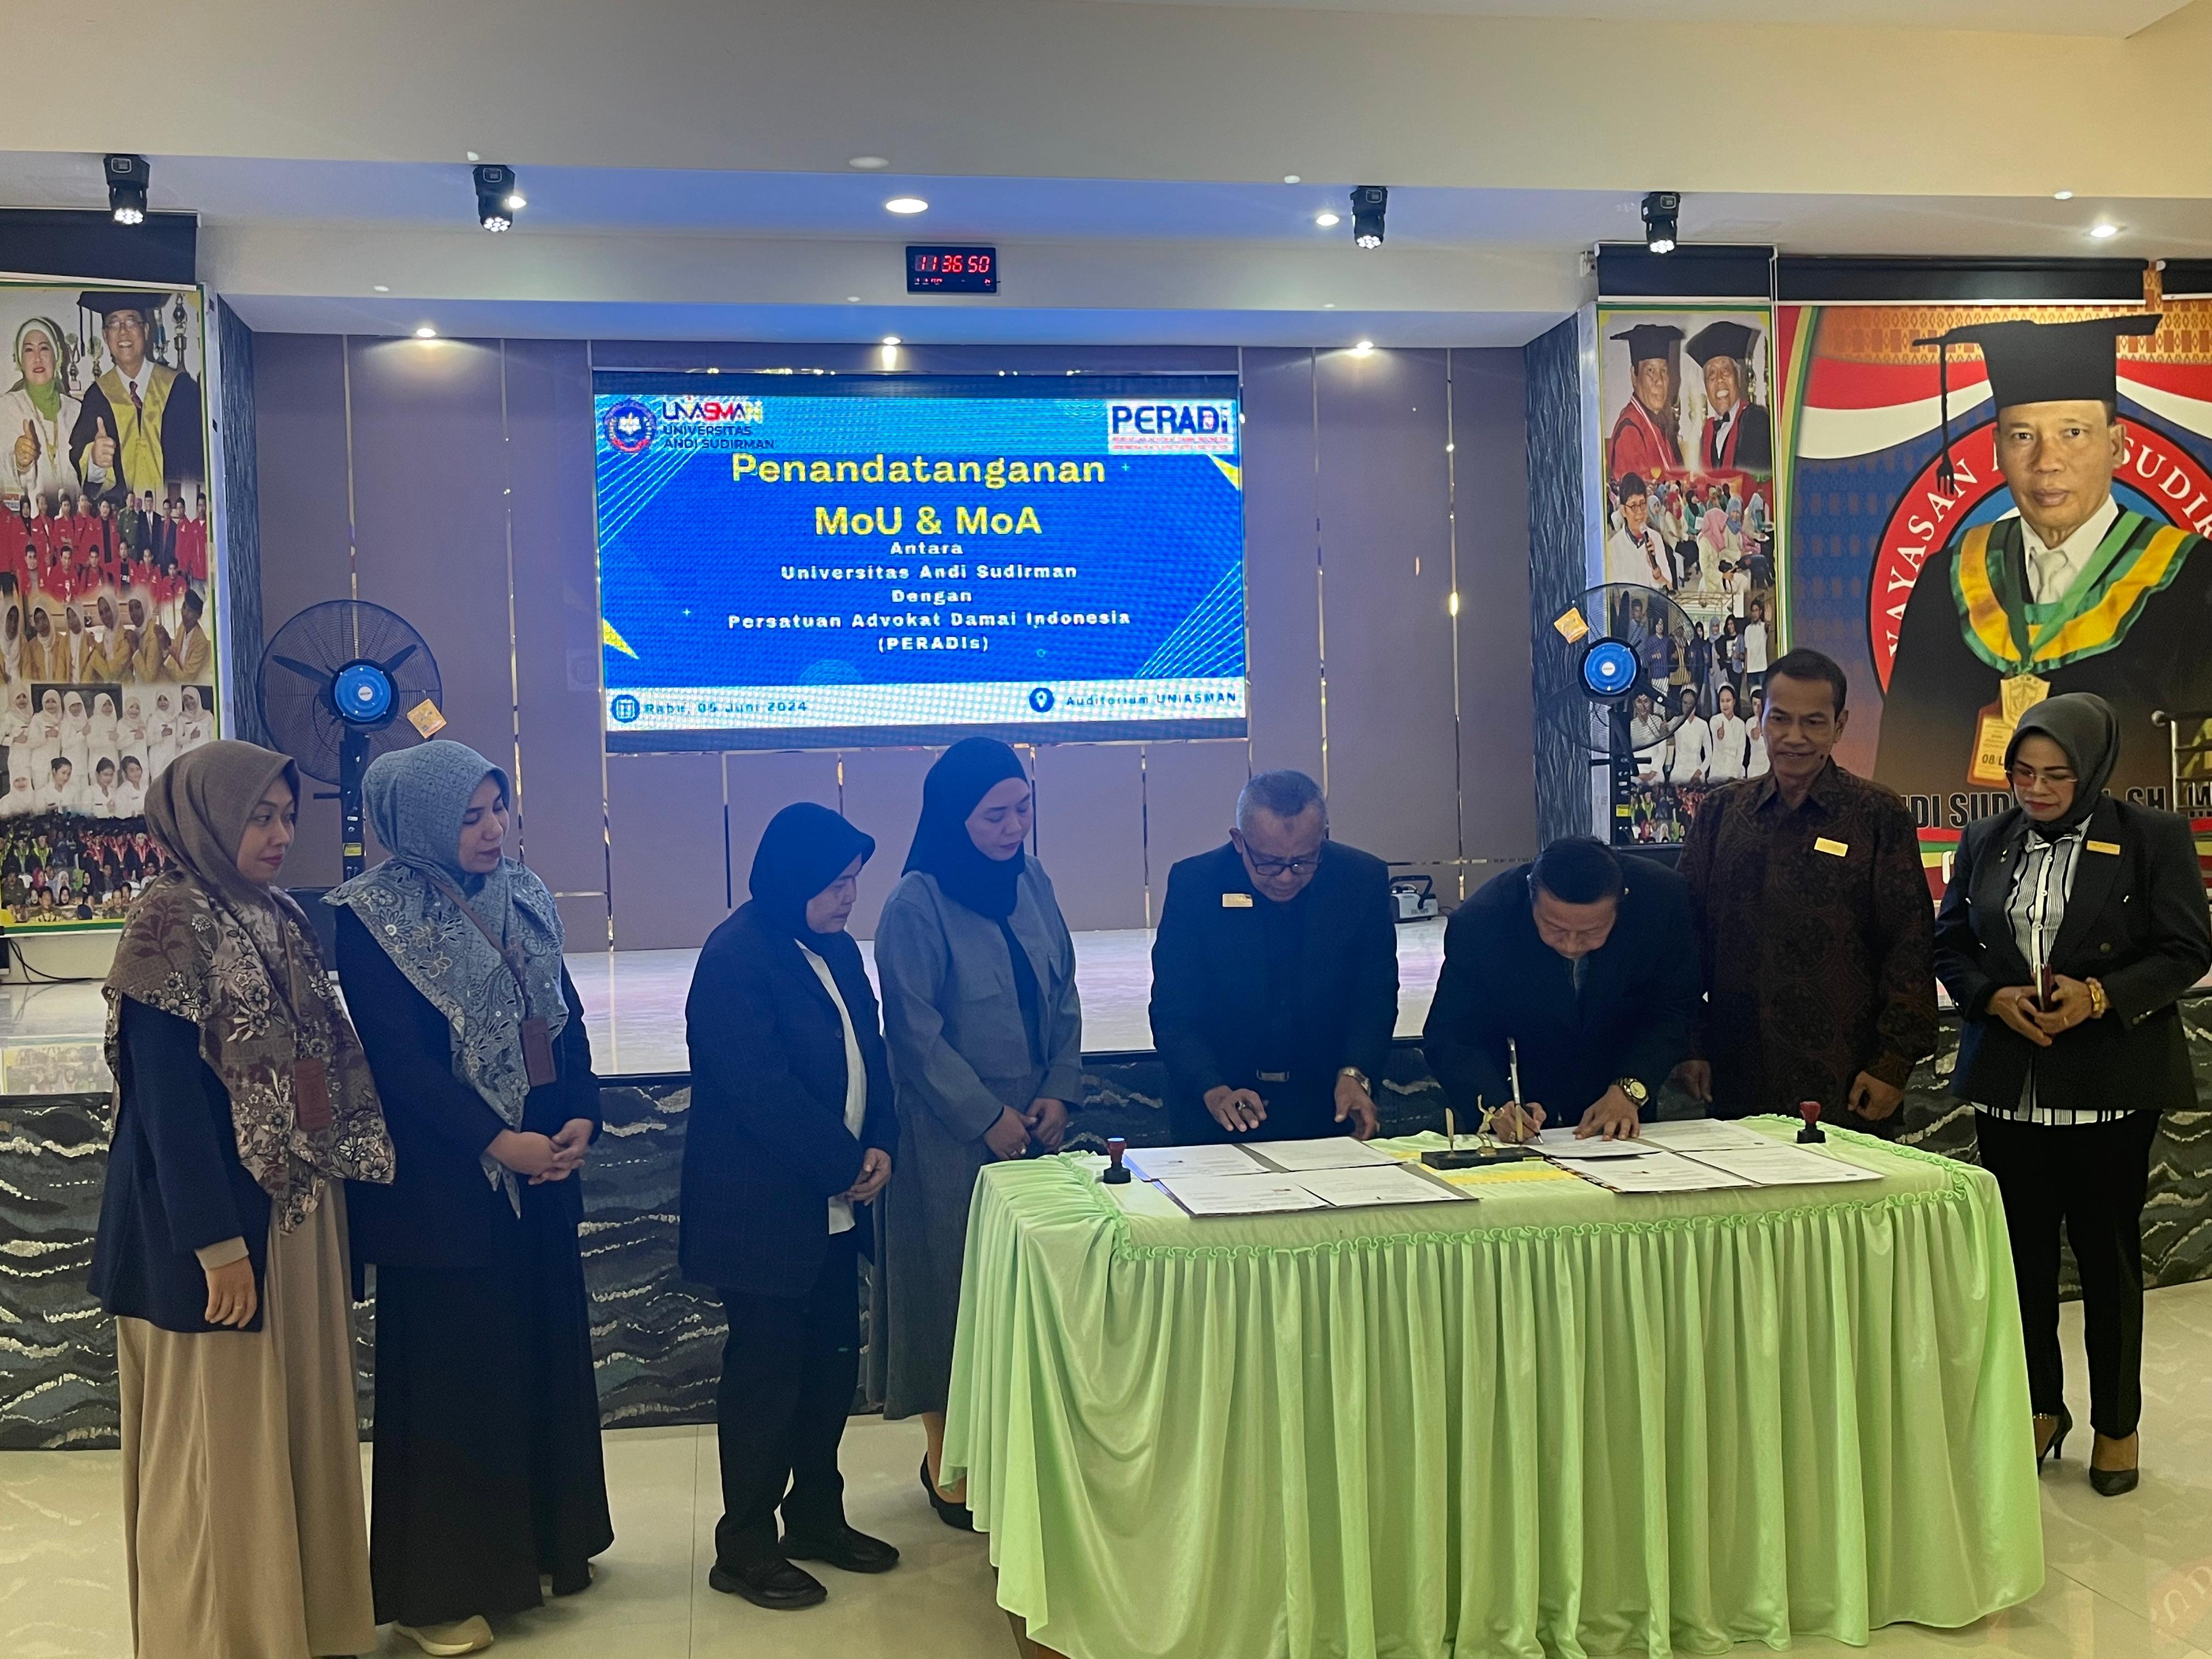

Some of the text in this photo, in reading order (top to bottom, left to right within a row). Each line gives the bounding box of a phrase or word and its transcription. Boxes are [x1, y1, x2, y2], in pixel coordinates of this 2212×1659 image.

[663, 426, 752, 436] UNIVERSITAS
[664, 439, 774, 449] ANDI SUDIRMAN
[732, 453, 1106, 489] Penandatanganan
[815, 505, 1042, 535] MoU & MoA
[890, 541, 963, 555] Antara
[781, 564, 1077, 580] Universitas Andi Sudirman
[891, 589, 972, 606] Dengan
[729, 609, 1130, 629] Persatuan Advokat Damai Indonesia
[878, 636, 988, 653] (PERADIs)
[1156, 692, 1237, 703] UNIASMAN
[725, 702, 759, 713] Juni
[768, 702, 806, 712] 2024
